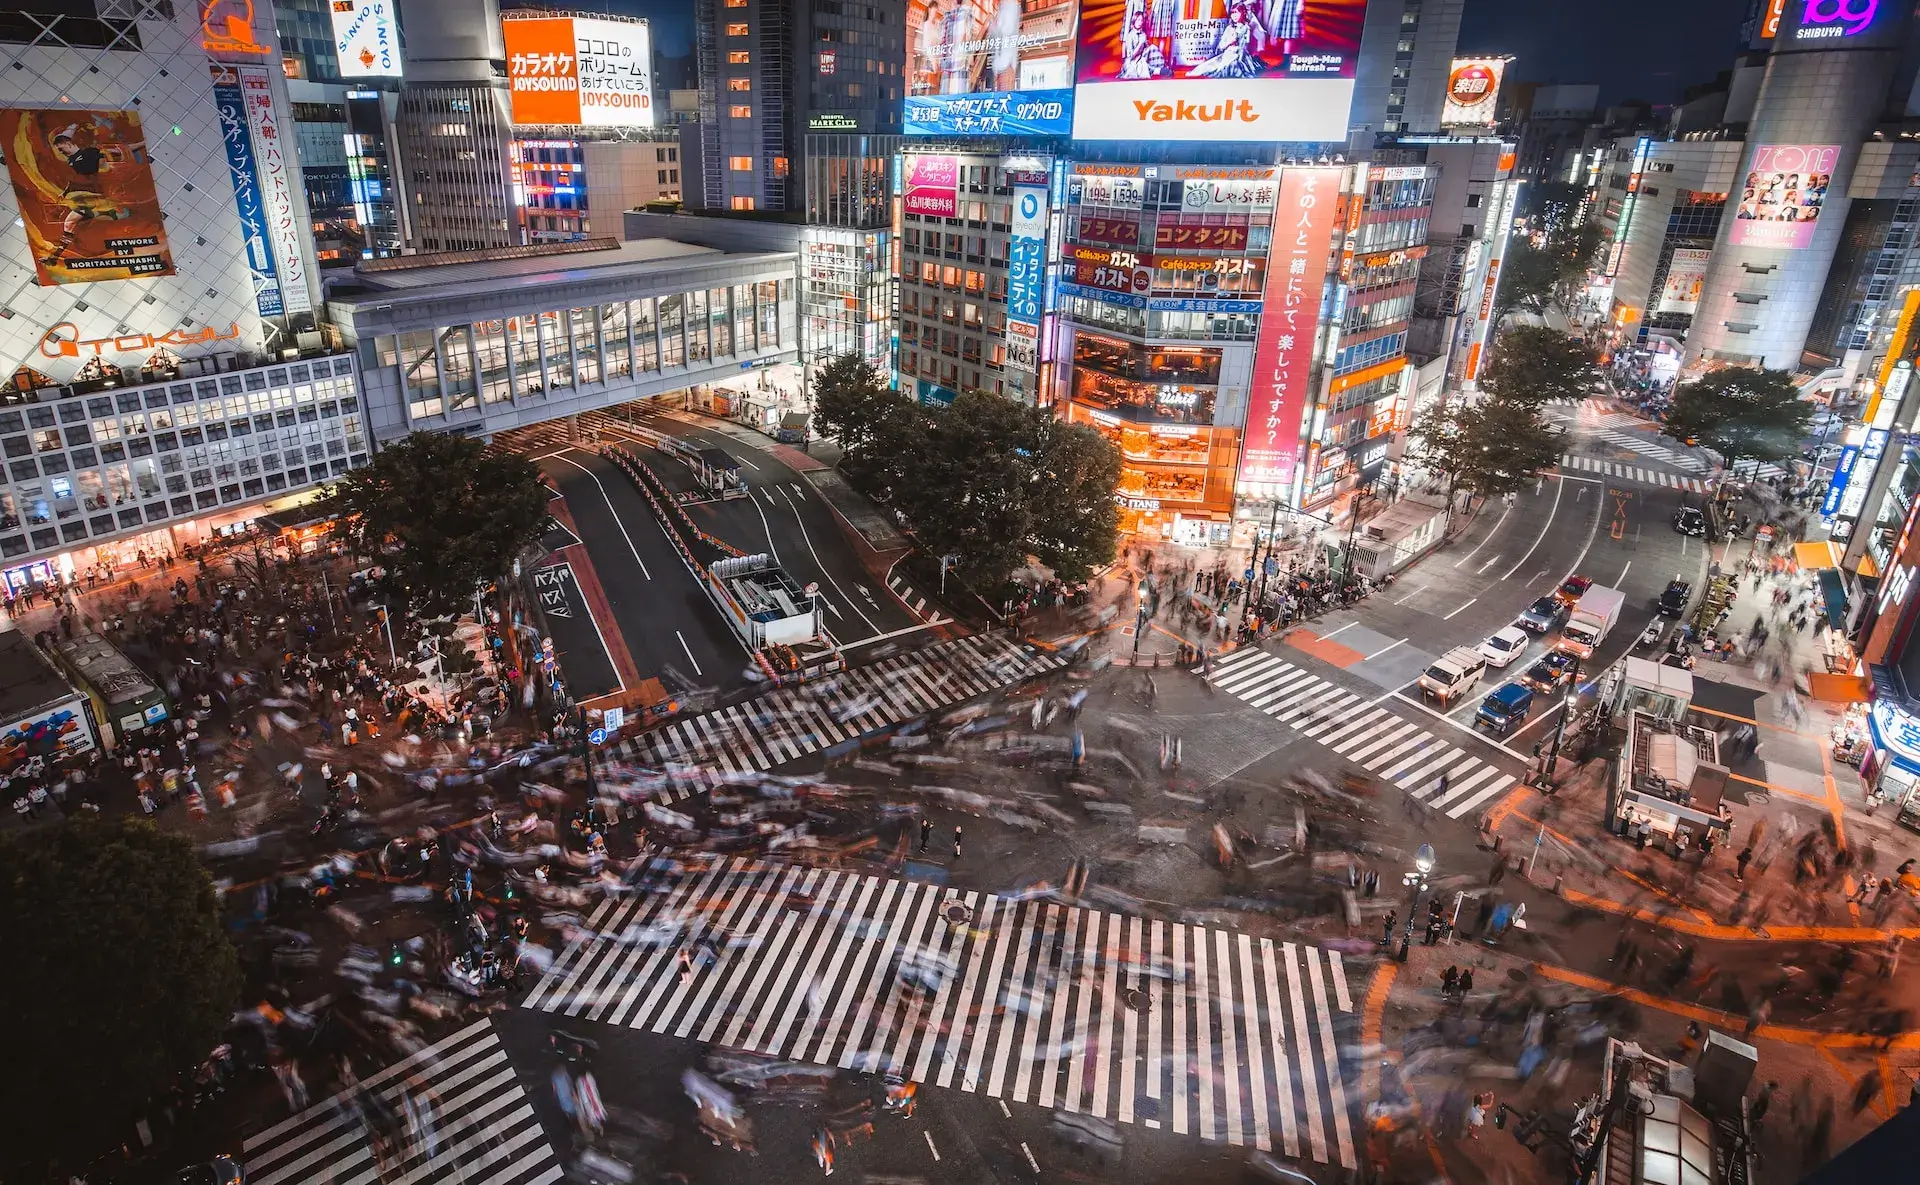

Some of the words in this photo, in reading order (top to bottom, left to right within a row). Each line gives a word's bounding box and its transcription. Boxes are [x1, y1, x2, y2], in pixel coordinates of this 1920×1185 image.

[339, 6, 370, 52] SANKYO
[374, 3, 391, 69] SANKYO
[1174, 31, 1211, 40] Refresh
[1797, 26, 1843, 39] SHIBUYA
[578, 38, 632, 58] ココロの
[511, 52, 574, 75] カラオケ
[580, 56, 647, 77] ボリューム、
[1289, 63, 1326, 72] Refresh
[1291, 54, 1342, 64] Tough-Man
[513, 76, 578, 92] JOYSOUND
[581, 76, 649, 92] あげていこう。
[581, 92, 650, 109] JOYSOUND
[945, 93, 1012, 115] スプリンターズ
[911, 106, 940, 122] 第53回
[1017, 99, 1062, 121] 9/29(日)
[1132, 99, 1260, 123] Yakult
[954, 115, 1004, 132] ステークス
[523, 141, 544, 149] カラオケ
[927, 173, 952, 183] クリニック
[1070, 184, 1081, 195] 9F
[1214, 185, 1272, 204] しゃぶ葉
[911, 196, 953, 212] 品川美容外科
[1081, 219, 1137, 240] プライス
[1156, 227, 1245, 246] コンタクト
[111, 238, 154, 246] ARTWORK
[71, 259, 117, 269] NORITAKE
[119, 257, 157, 266] KINASHI
[1109, 251, 1140, 269] ガスト
[1213, 258, 1256, 274] ガスト
[1026, 236, 1040, 316] ンタクトの
[1064, 263, 1076, 276] 7F
[1094, 266, 1129, 288] ガスト
[1081, 287, 1131, 304] 英会話イーオン
[1184, 300, 1260, 312] 英会話イーオン
[78, 321, 239, 355] TOKYU
[1363, 443, 1388, 465] LUSH
